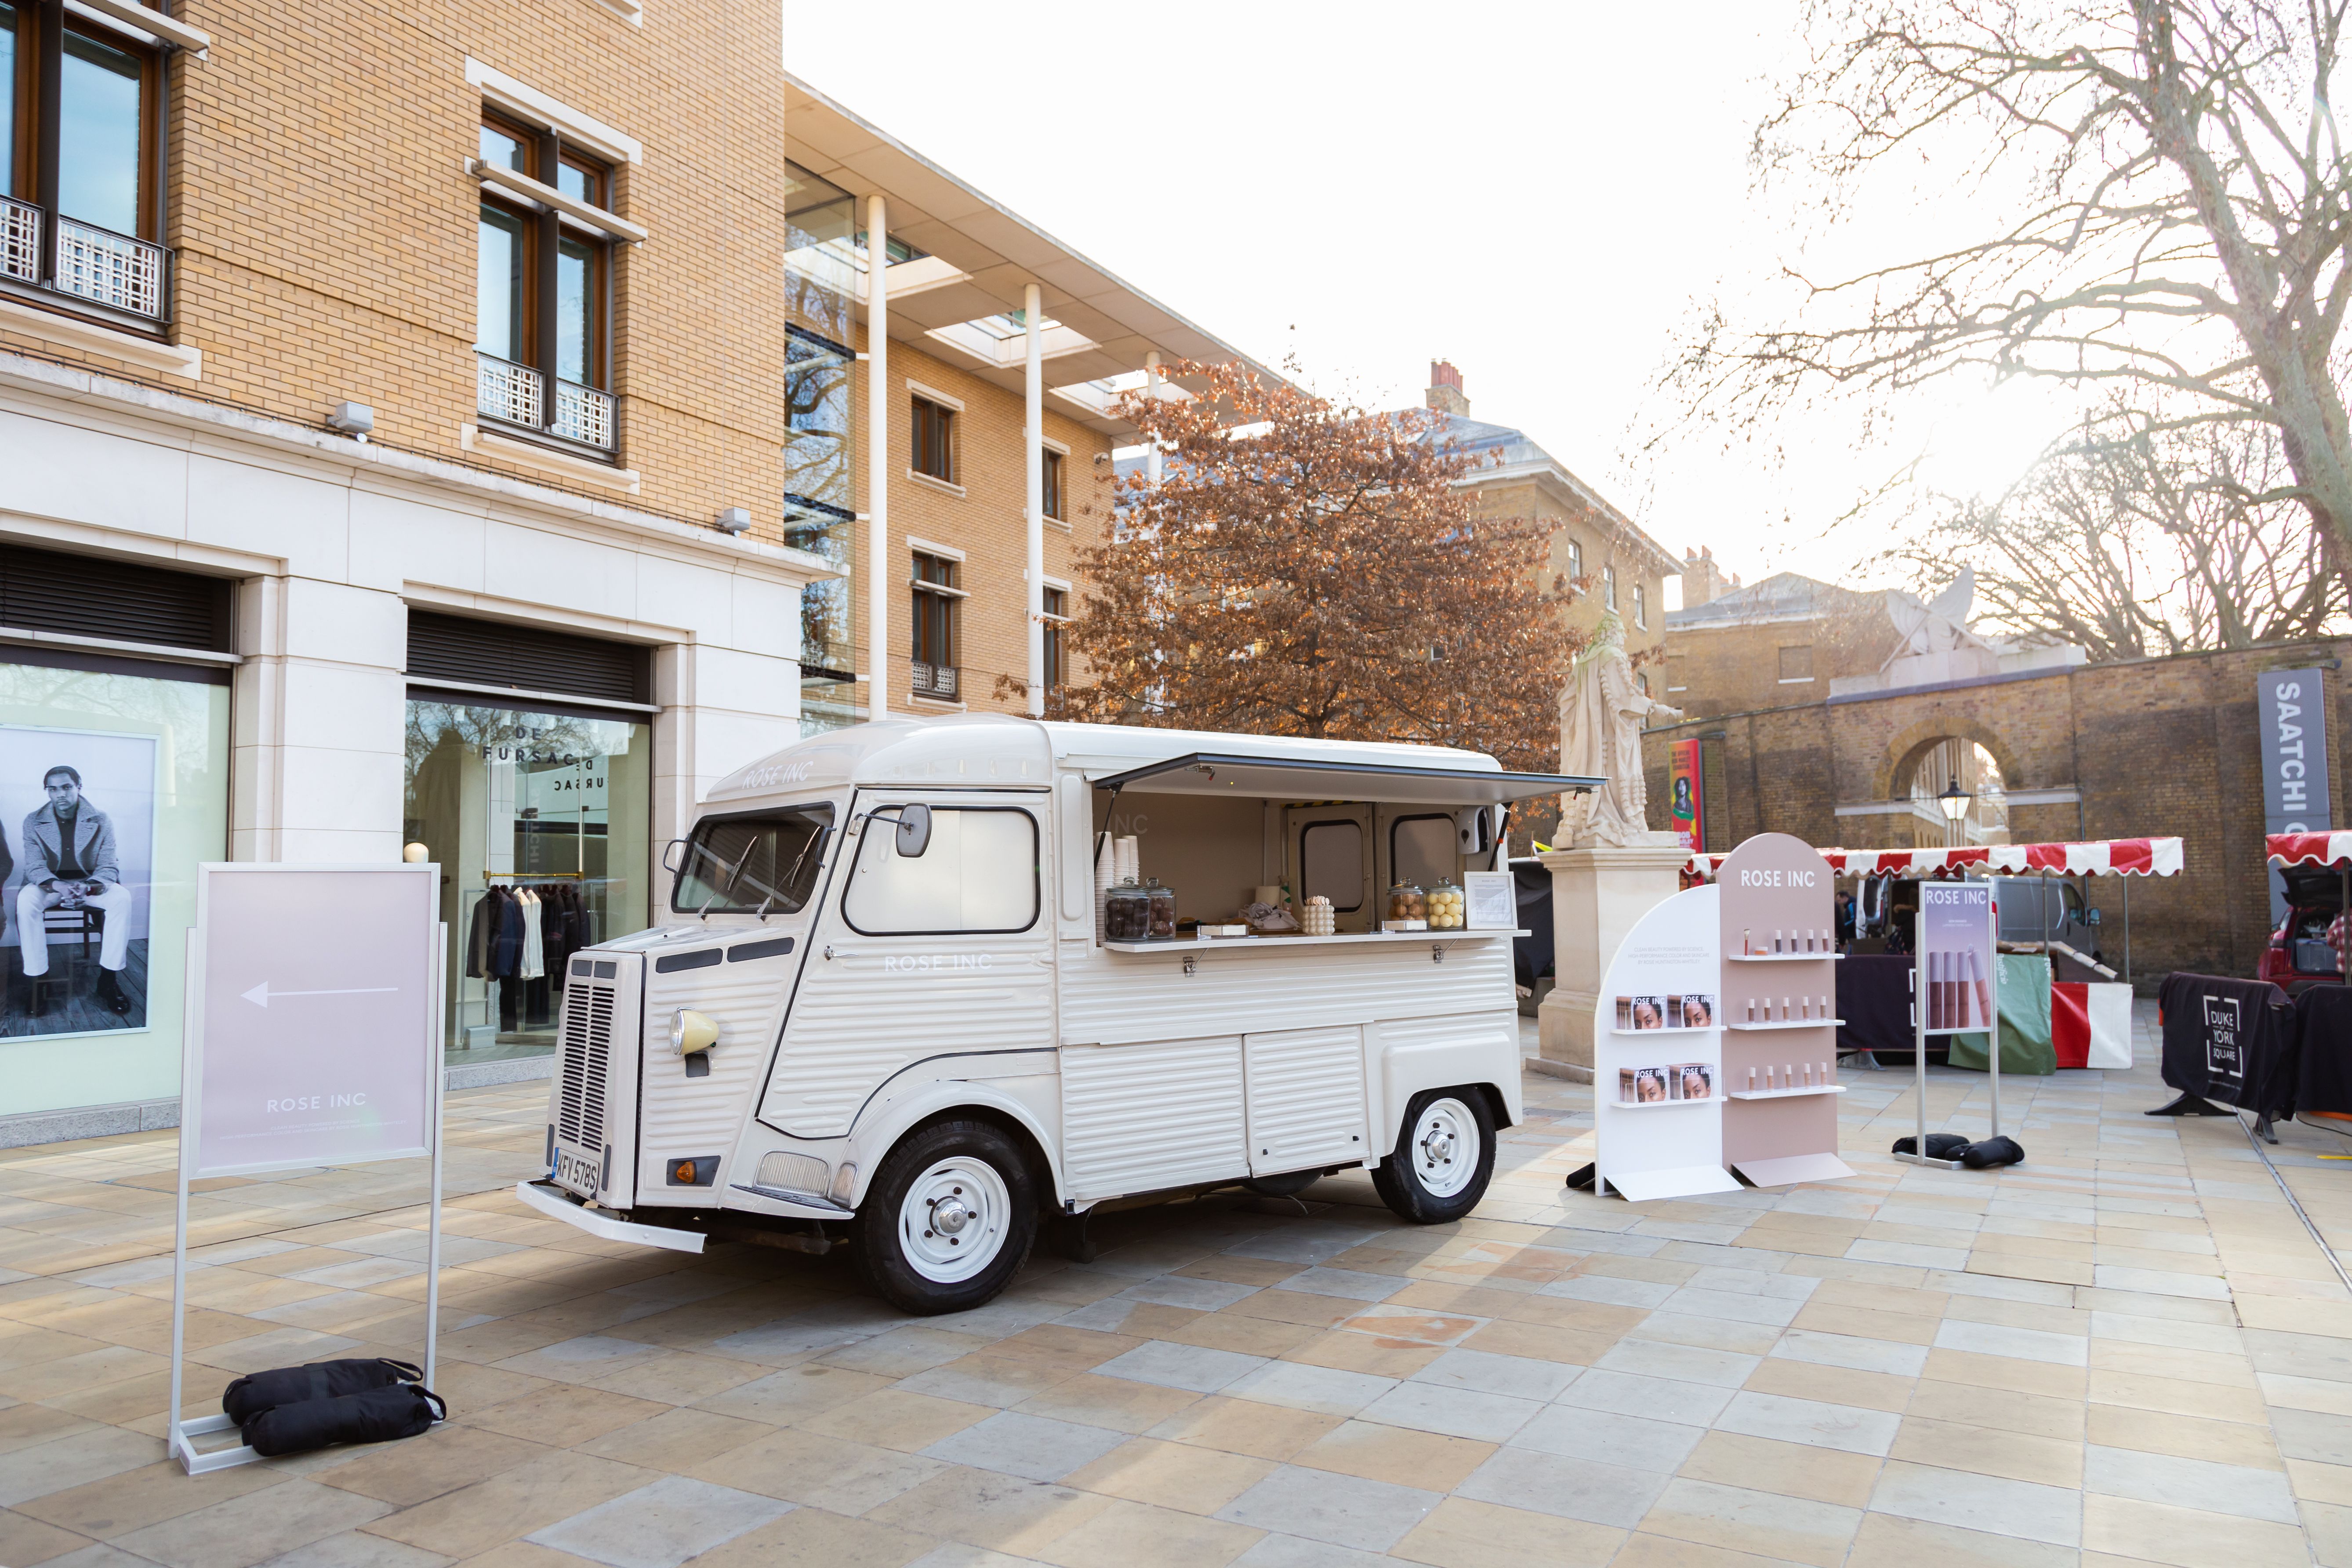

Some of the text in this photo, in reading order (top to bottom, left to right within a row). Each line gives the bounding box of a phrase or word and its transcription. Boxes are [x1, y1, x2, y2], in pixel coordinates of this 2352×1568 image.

[515, 726, 541, 740] DE
[2276, 682, 2307, 811] SAATCHI
[483, 746, 573, 765] FURSAC
[742, 761, 813, 789] ROSE INC
[1741, 870, 1815, 887] ROSE INC
[1926, 890, 1986, 905] ROSE INC
[885, 953, 992, 972] ROSE INC
[2211, 1011, 2233, 1027] DUKE
[2213, 1029, 2234, 1045] YORK
[2214, 1048, 2235, 1061] SQUARE
[1636, 1070, 1653, 1078] ROSE
[267, 1093, 366, 1113] ROSE INC
[557, 1153, 596, 1190] XFV 578S
